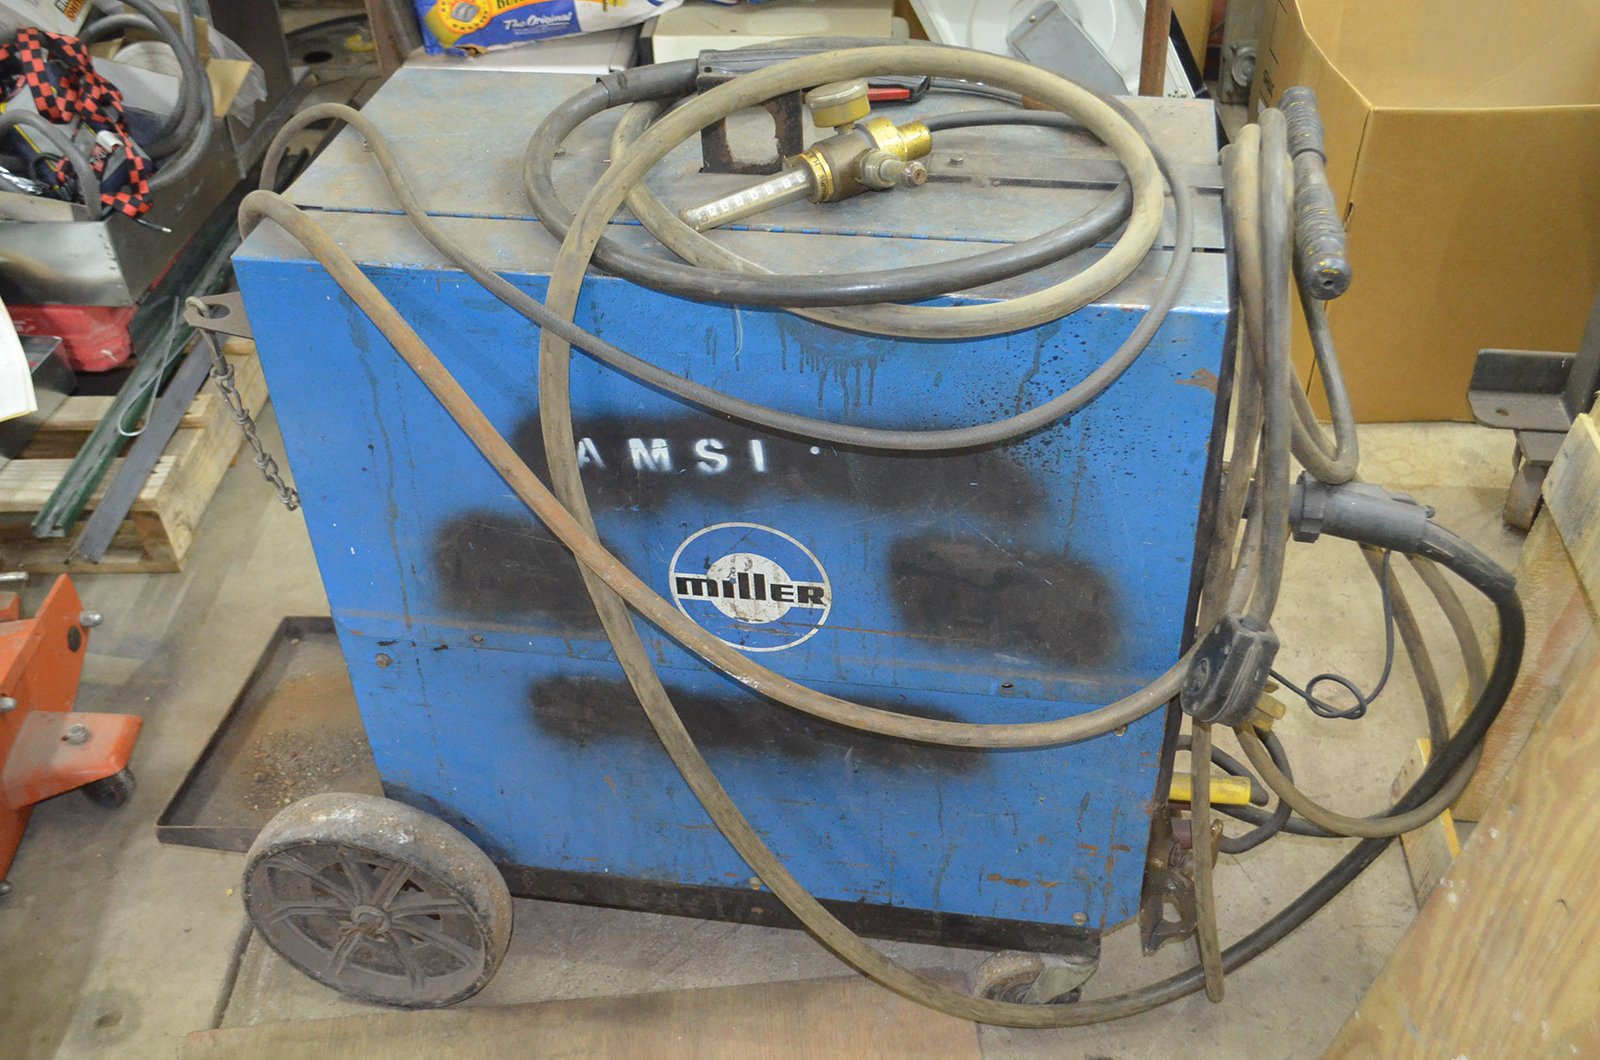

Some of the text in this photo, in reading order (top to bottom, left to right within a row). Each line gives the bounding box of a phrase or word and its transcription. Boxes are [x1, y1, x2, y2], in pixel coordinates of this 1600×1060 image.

[503, 11, 573, 30] The Original
[576, 437, 769, 474] AMSI
